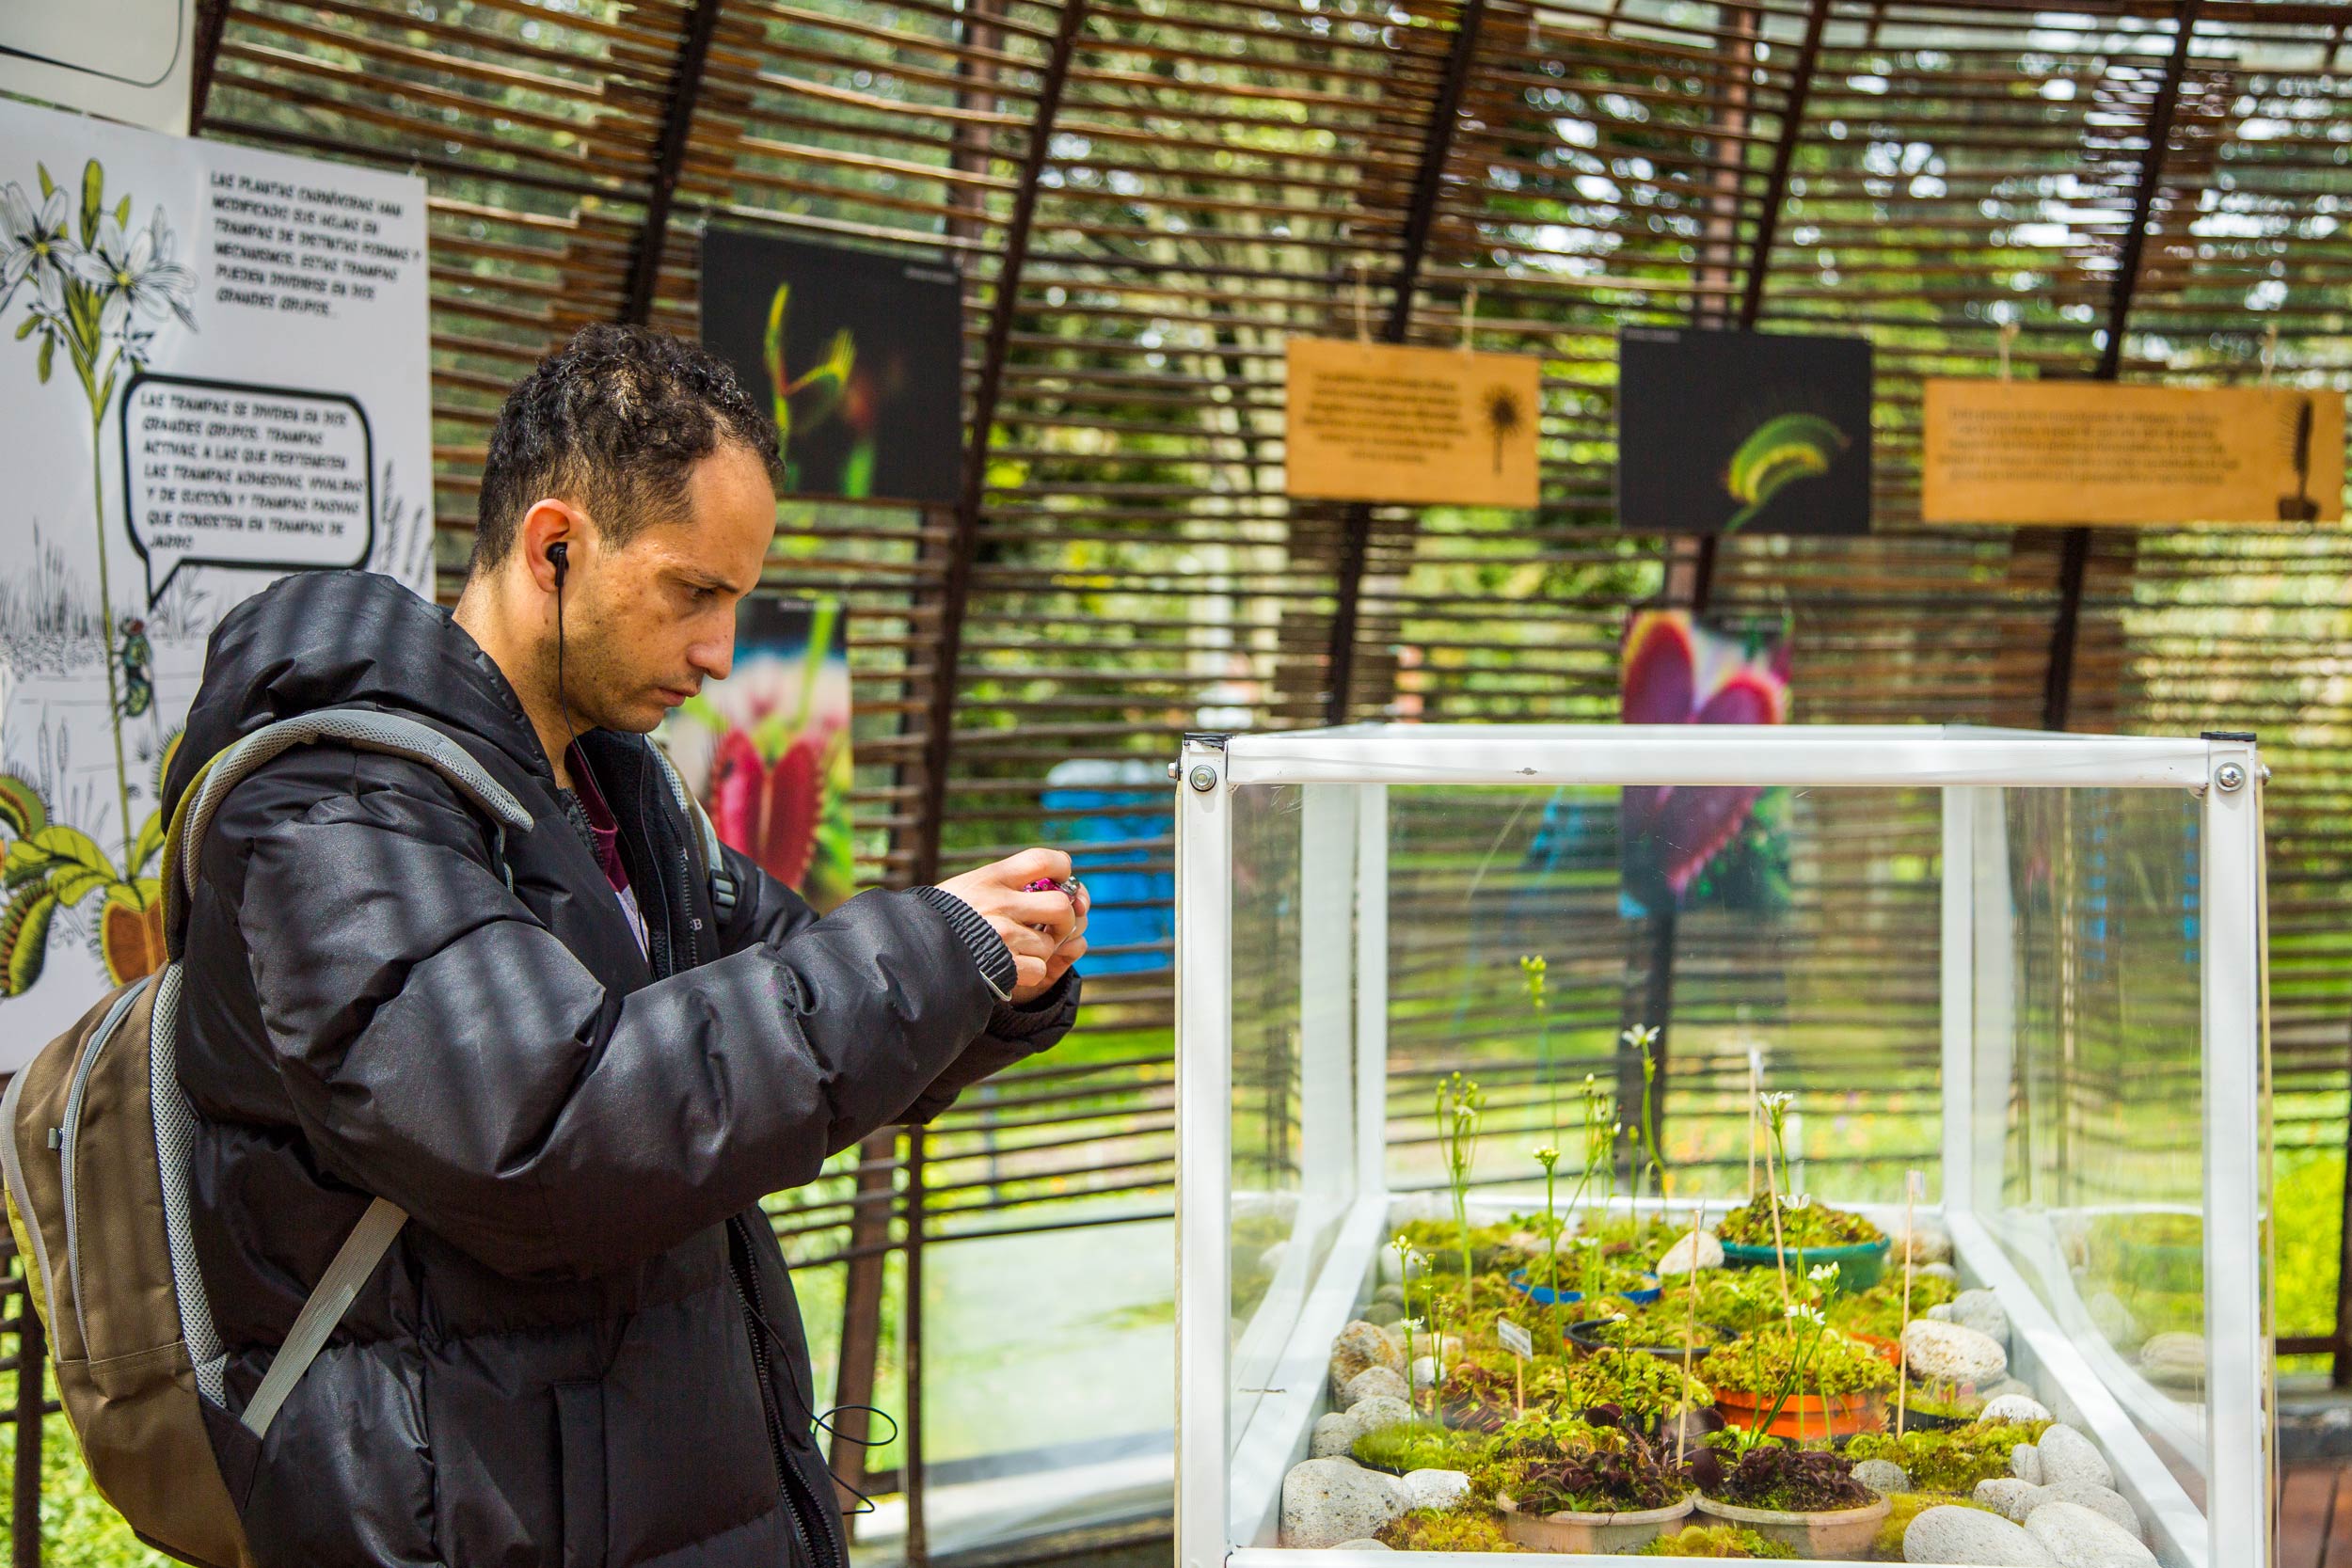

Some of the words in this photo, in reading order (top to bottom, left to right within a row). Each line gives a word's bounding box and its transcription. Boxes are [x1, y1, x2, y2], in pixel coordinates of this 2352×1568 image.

[211, 171, 234, 188] LAS
[239, 176, 294, 198] PLANTAS
[378, 202, 403, 216] HAN
[293, 209, 315, 223] SUS
[320, 214, 359, 232] HOJAS
[362, 220, 380, 234] EN
[215, 218, 273, 240] TRAMPAS
[278, 230, 294, 243] DE
[299, 232, 358, 253] DISTINTAS
[362, 243, 408, 260] FORMAS
[413, 249, 421, 261] Y
[215, 264, 264, 282] PUEDEN
[270, 273, 327, 293] DIVIDIRSE
[331, 281, 346, 294] EN
[351, 284, 375, 299] DOS
[300, 255, 338, 272] ESTAS
[342, 261, 398, 281] TRAMPAS
[217, 287, 275, 309] GRANDES
[141, 391, 164, 407] LAS
[171, 395, 229, 415] TRAMPAS
[233, 403, 248, 416] SE
[251, 404, 298, 422] DIVIDEN
[303, 411, 318, 423] EN
[324, 413, 347, 426] DOS
[143, 417, 201, 436] GRANDES
[267, 427, 323, 446] TRAMPAS
[202, 448, 211, 459] A
[215, 449, 239, 462] LAS
[242, 451, 267, 465] QUE
[271, 451, 347, 470] PERTENECEN
[145, 465, 167, 479] LAS
[174, 466, 232, 484] TRAMPAS
[147, 487, 156, 499] Y
[160, 487, 177, 501] DE
[239, 495, 247, 507] Y
[251, 494, 308, 512] TRAMPAS
[311, 499, 359, 515] PASIVAS
[147, 511, 173, 527] QUE
[177, 512, 243, 530] CONSISTEN
[249, 518, 264, 531] EN
[269, 517, 325, 535] TRAMPAS
[329, 522, 344, 536] DE
